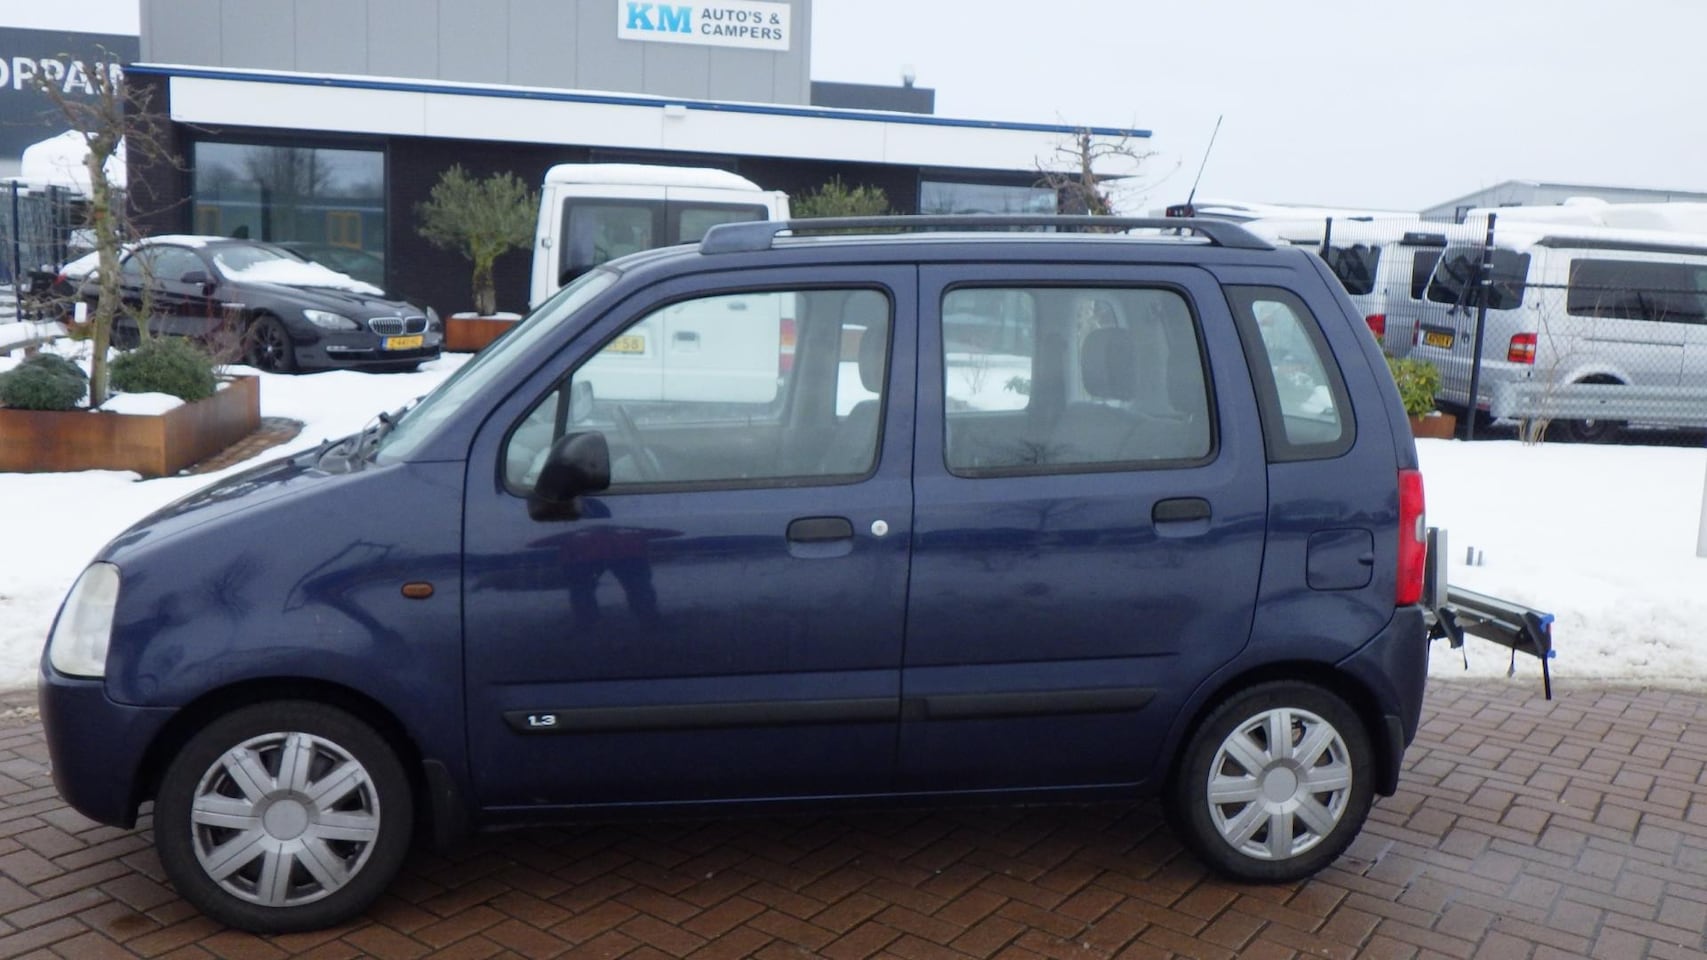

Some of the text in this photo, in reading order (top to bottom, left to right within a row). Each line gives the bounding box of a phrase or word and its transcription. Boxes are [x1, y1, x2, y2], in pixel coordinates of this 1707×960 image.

[626, 2, 692, 33] KM
[701, 8, 781, 25] AUTO'S &
[701, 23, 783, 41] CAMPERS
[528, 715, 556, 726] 1.3
